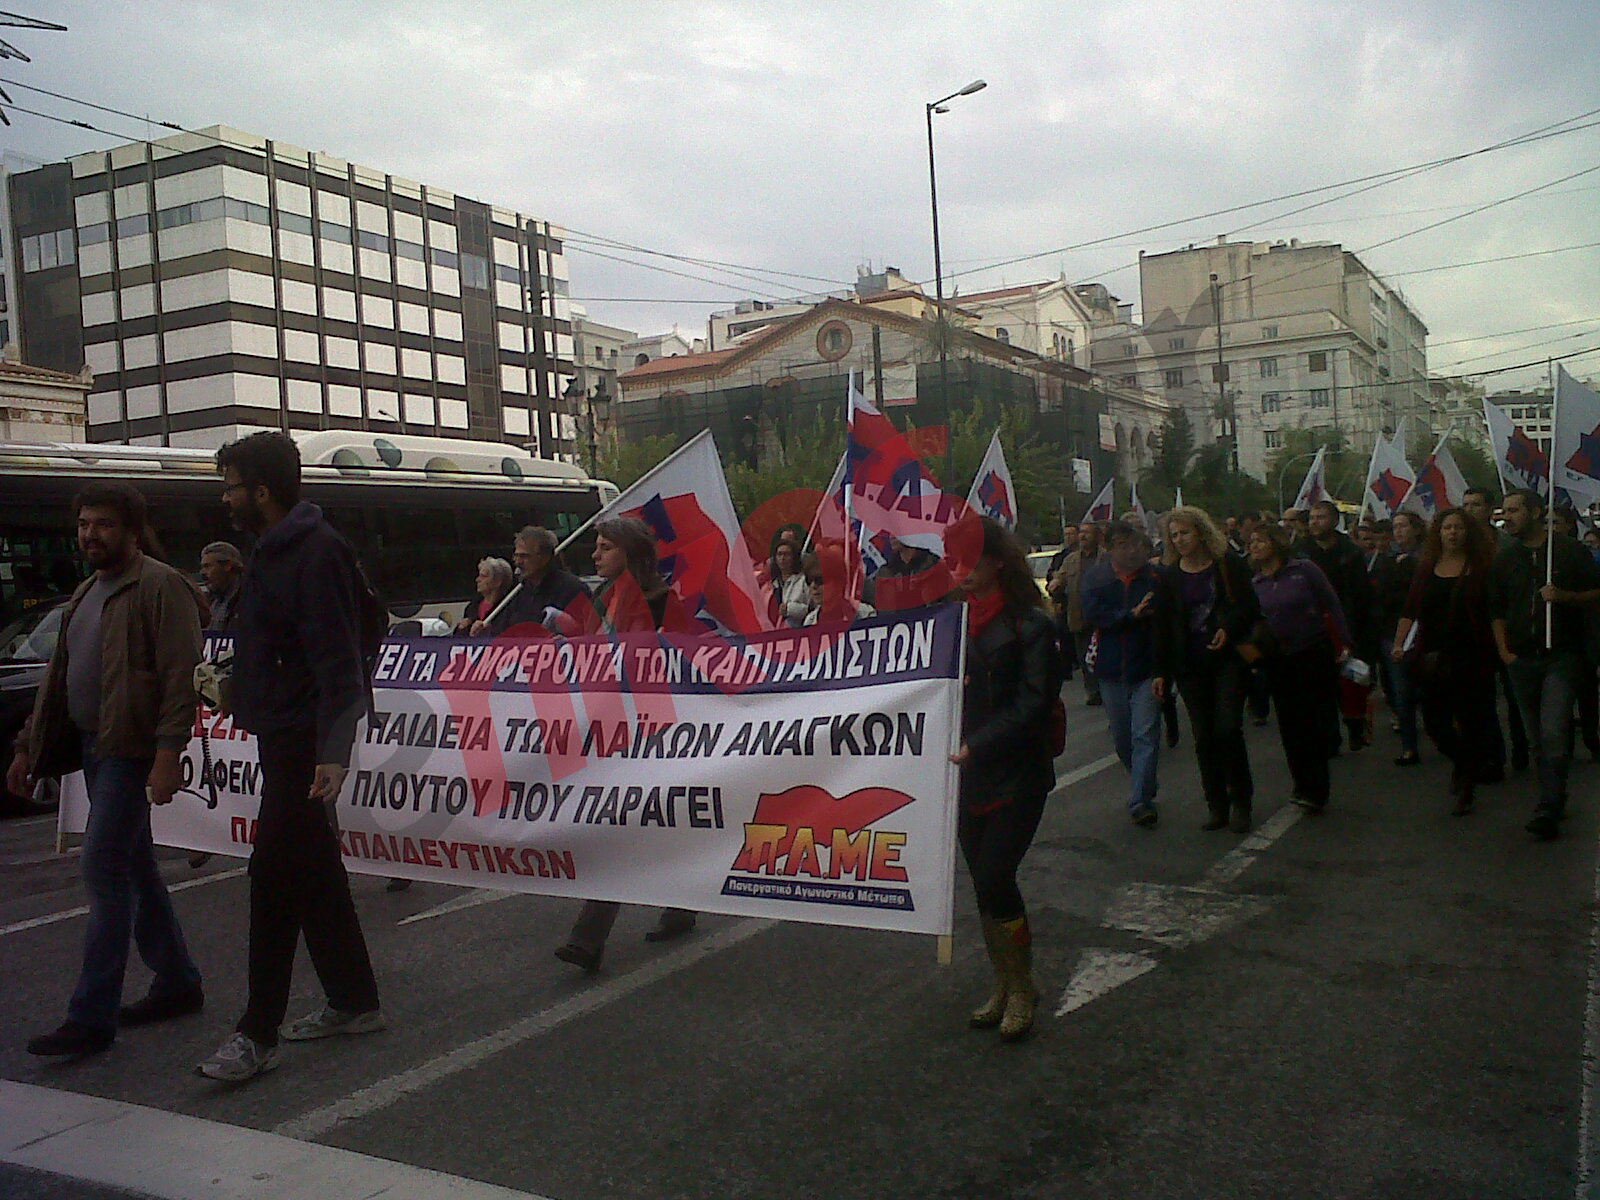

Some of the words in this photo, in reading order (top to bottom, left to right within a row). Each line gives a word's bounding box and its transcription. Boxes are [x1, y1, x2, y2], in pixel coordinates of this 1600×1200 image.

[375, 643, 410, 681] ΕΙ
[409, 652, 438, 681] ΤΑ
[439, 641, 627, 684] ΣΥΜΦΕΡΟΝΤΑ
[635, 647, 683, 684] ΤΩΝ
[690, 618, 936, 685] ΚΑΠΙΤΑΛΙΣΤΩΝ
[365, 712, 493, 751] ΠΑΙΔΕΙΑ
[504, 718, 574, 756] ΤΩΝ
[580, 713, 725, 759] ΛΑΪΚΩΝ
[725, 711, 926, 757] ΑΝΑΓΚΩΝ
[199, 758, 262, 796] ΑΦΕΝ
[351, 770, 493, 817] ΠΛΟΥΤΟΥ
[498, 780, 575, 823] ΠΟΥ
[573, 785, 724, 830] ΠΑΡΑΓΕΙ
[340, 829, 576, 880] ΚΠΑΙΔΕΥΤΙΚΩΝ
